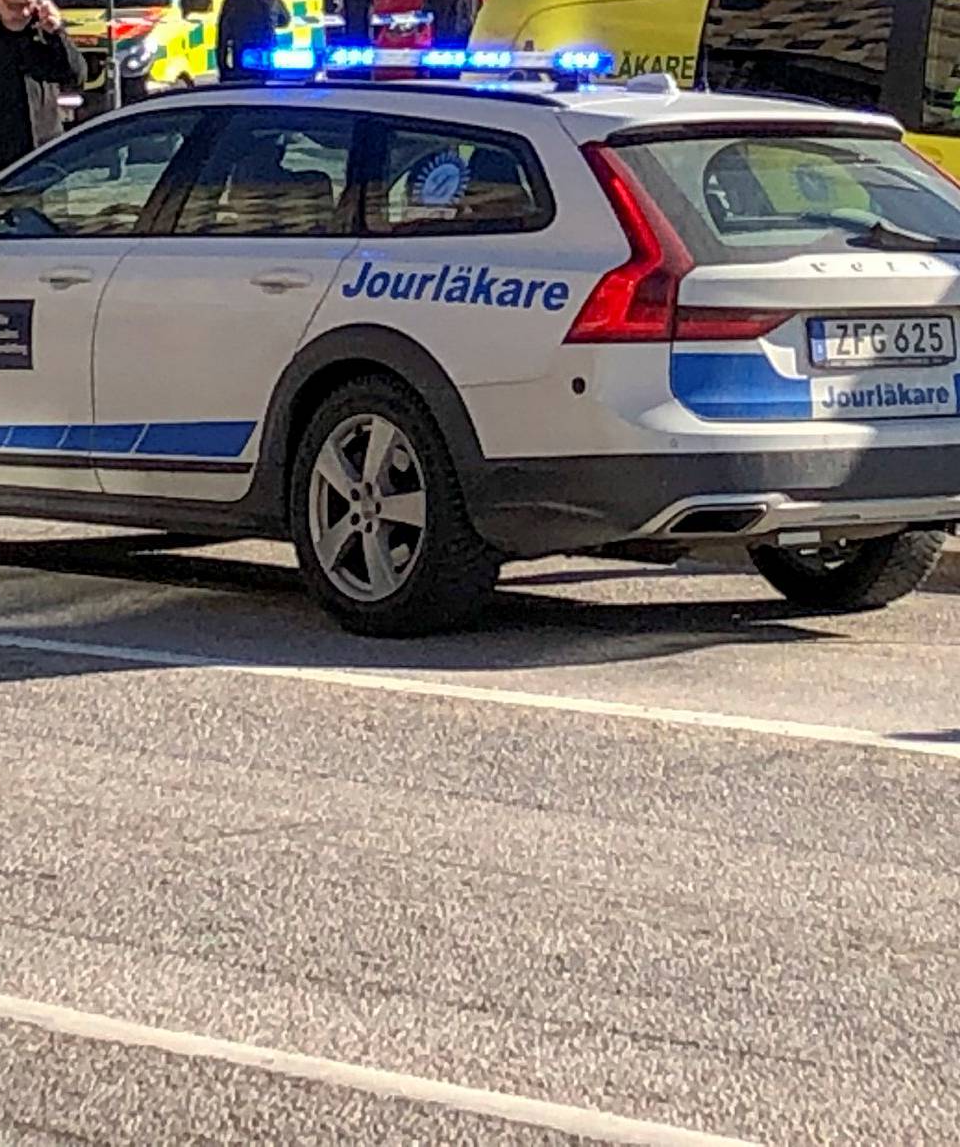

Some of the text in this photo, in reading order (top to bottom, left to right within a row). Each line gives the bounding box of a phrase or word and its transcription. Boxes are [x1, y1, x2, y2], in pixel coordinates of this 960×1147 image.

[607, 51, 695, 81] ÄKARE
[342, 261, 570, 311] Jourläkare
[836, 322, 944, 356] ZFG 625
[821, 382, 950, 408] Jourläkare
